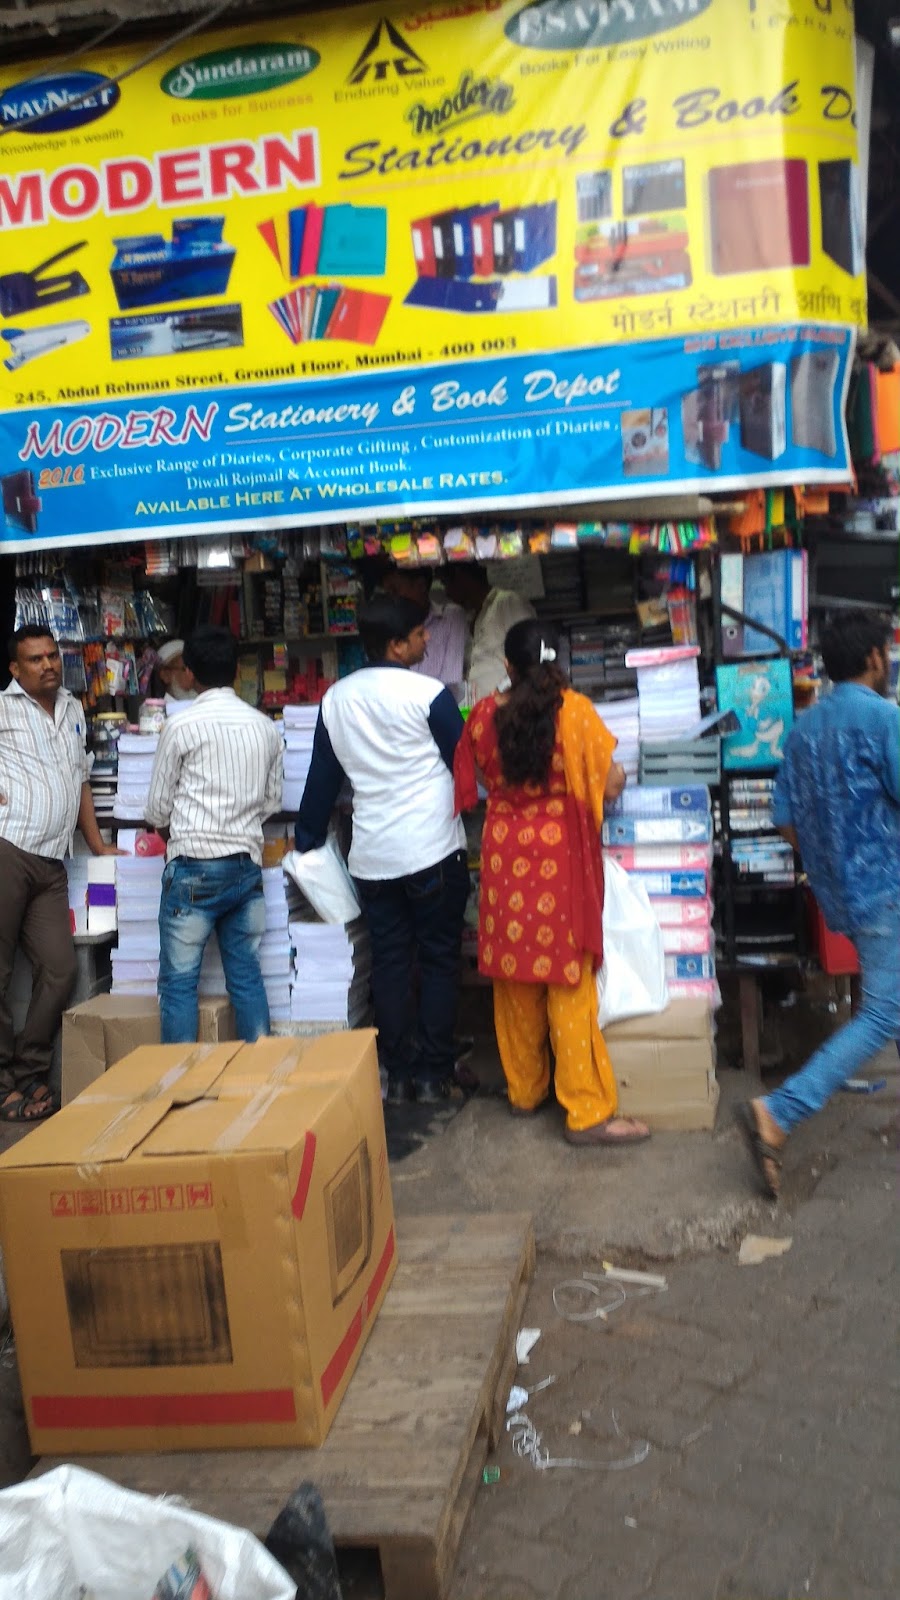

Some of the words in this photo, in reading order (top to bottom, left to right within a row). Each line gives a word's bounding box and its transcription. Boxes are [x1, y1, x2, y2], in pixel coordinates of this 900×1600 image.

[169, 50, 310, 98] Sundaram
[520, 59, 569, 75] Books
[573, 51, 600, 68] For
[607, 46, 648, 62] Easy
[652, 35, 711, 53] Writing
[2, 87, 112, 121] NAVNEET
[171, 107, 218, 125] Books
[222, 104, 242, 117] for
[248, 94, 314, 113] Success
[334, 82, 401, 103] Enduring
[404, 76, 446, 91] Value
[0, 139, 68, 156] Knowledge
[71, 137, 81, 146] is
[83, 128, 124, 145] wealth
[338, 124, 588, 180] Stationery
[609, 98, 646, 138] &
[672, 80, 800, 129] Book
[0, 131, 318, 227] MODERN
[15, 391, 51, 404] 245,
[57, 385, 100, 400] Abdul
[105, 378, 170, 394] Rehman
[175, 371, 229, 387] Street,
[235, 364, 295, 380] Ground
[301, 358, 350, 372] Floor,
[356, 348, 422, 367] Mumbai
[441, 342, 475, 357] 400
[481, 337, 517, 351] 003
[19, 402, 218, 460] MODERN
[224, 401, 378, 434] Stationery
[391, 384, 416, 416] &
[430, 375, 508, 412] Book
[523, 368, 621, 405] Depot
[38, 463, 86, 488] 2016
[90, 462, 153, 480] Exclusive
[156, 458, 199, 474] Range
[203, 453, 217, 467] of
[220, 450, 275, 466] Diaries,
[280, 443, 354, 463] Corporate
[421, 427, 533, 448] Customization
[536, 422, 551, 437] of
[187, 475, 229, 491] Diwali
[232, 469, 283, 487] Rojmail
[287, 467, 300, 480] &
[304, 463, 364, 479] Account
[370, 457, 411, 472] Book.
[316, 477, 434, 500] WHOLESALE
